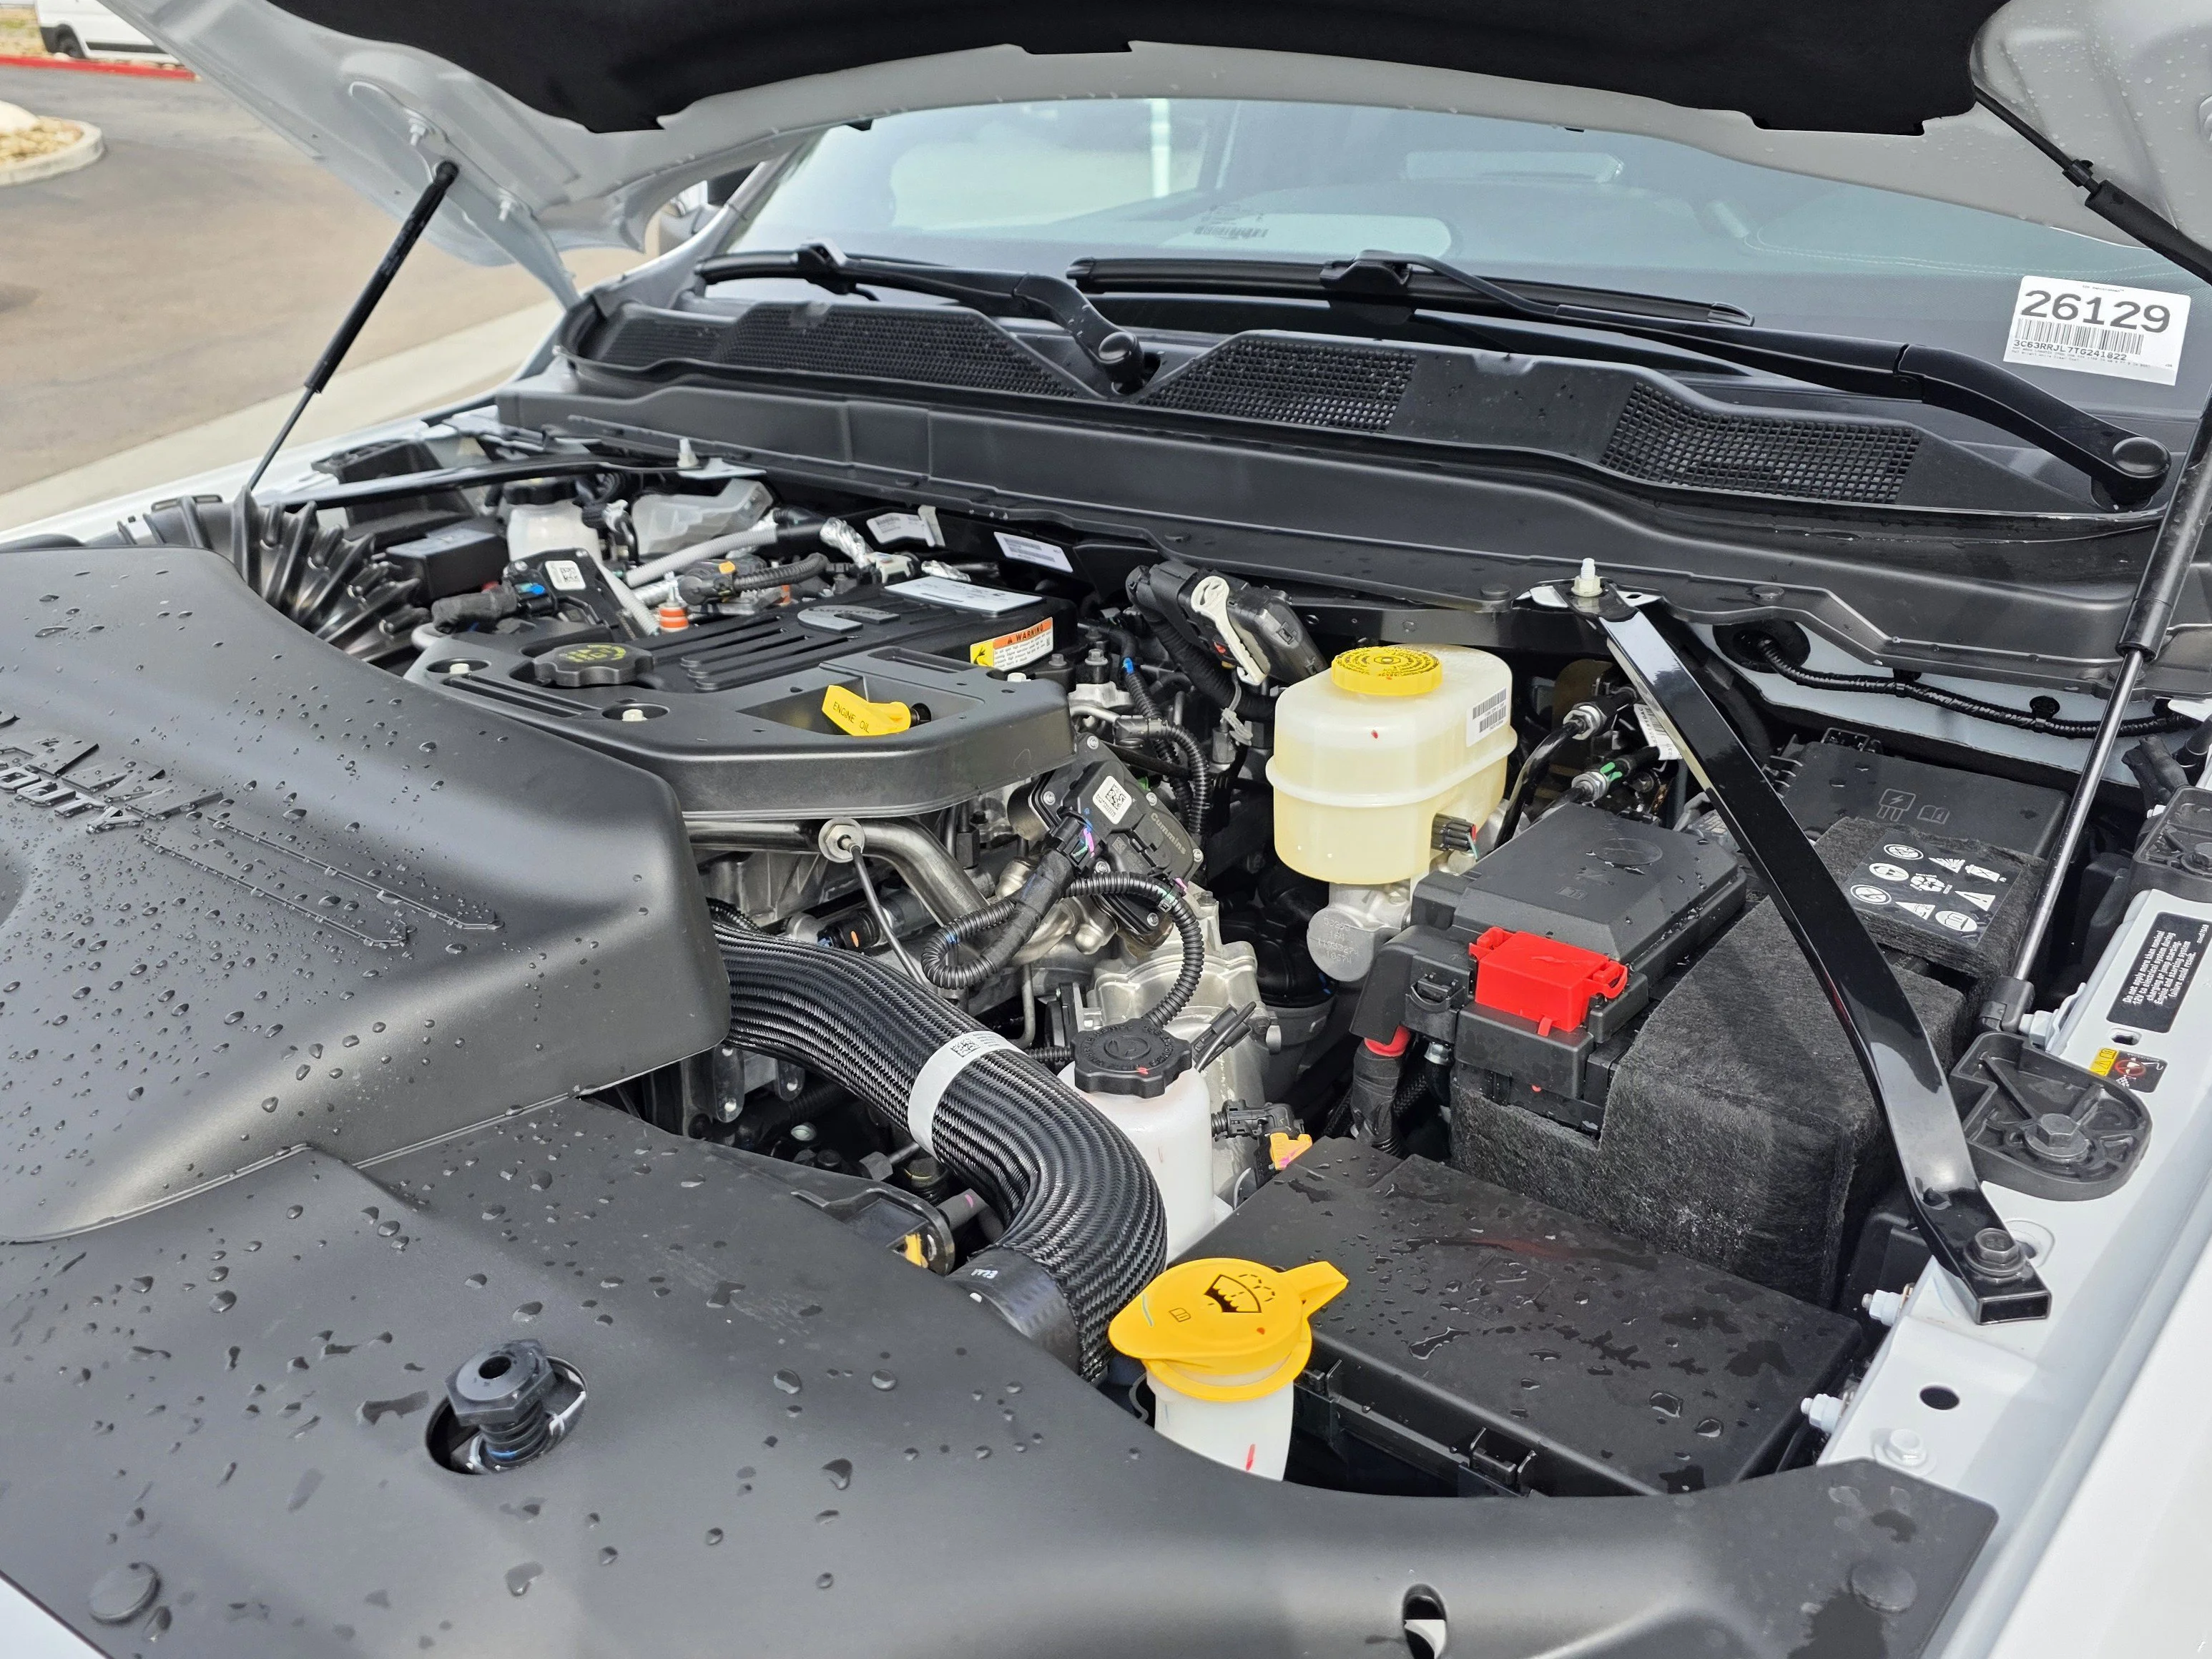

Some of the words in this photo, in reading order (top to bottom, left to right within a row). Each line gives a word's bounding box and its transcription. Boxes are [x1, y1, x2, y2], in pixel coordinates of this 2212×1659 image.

[2021, 290, 2171, 333] 26129
[1016, 624, 1043, 641] WARNING
[832, 701, 856, 723] ENGINE
[860, 720, 870, 734] OIL
[1151, 812, 1186, 855] Cummins
